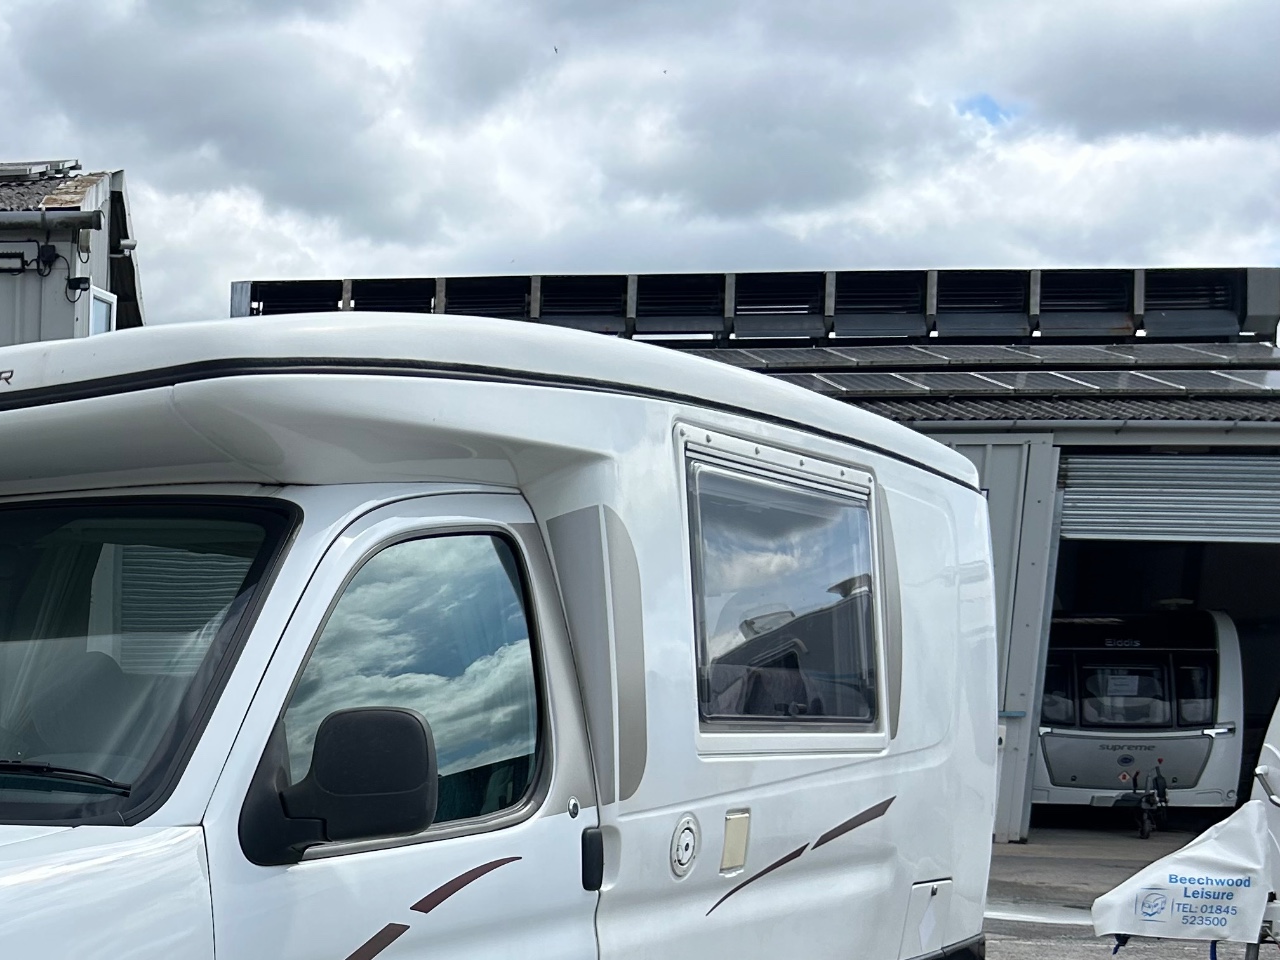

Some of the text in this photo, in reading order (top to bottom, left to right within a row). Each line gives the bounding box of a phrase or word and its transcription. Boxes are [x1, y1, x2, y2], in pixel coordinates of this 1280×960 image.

[1105, 638, 1141, 647] Elddis
[1099, 743, 1156, 751] supreme
[1168, 874, 1251, 887] Beechwood
[1184, 887, 1234, 900] Leisure
[1175, 902, 1238, 915] TEL: 01845
[1182, 915, 1228, 926] 523500
